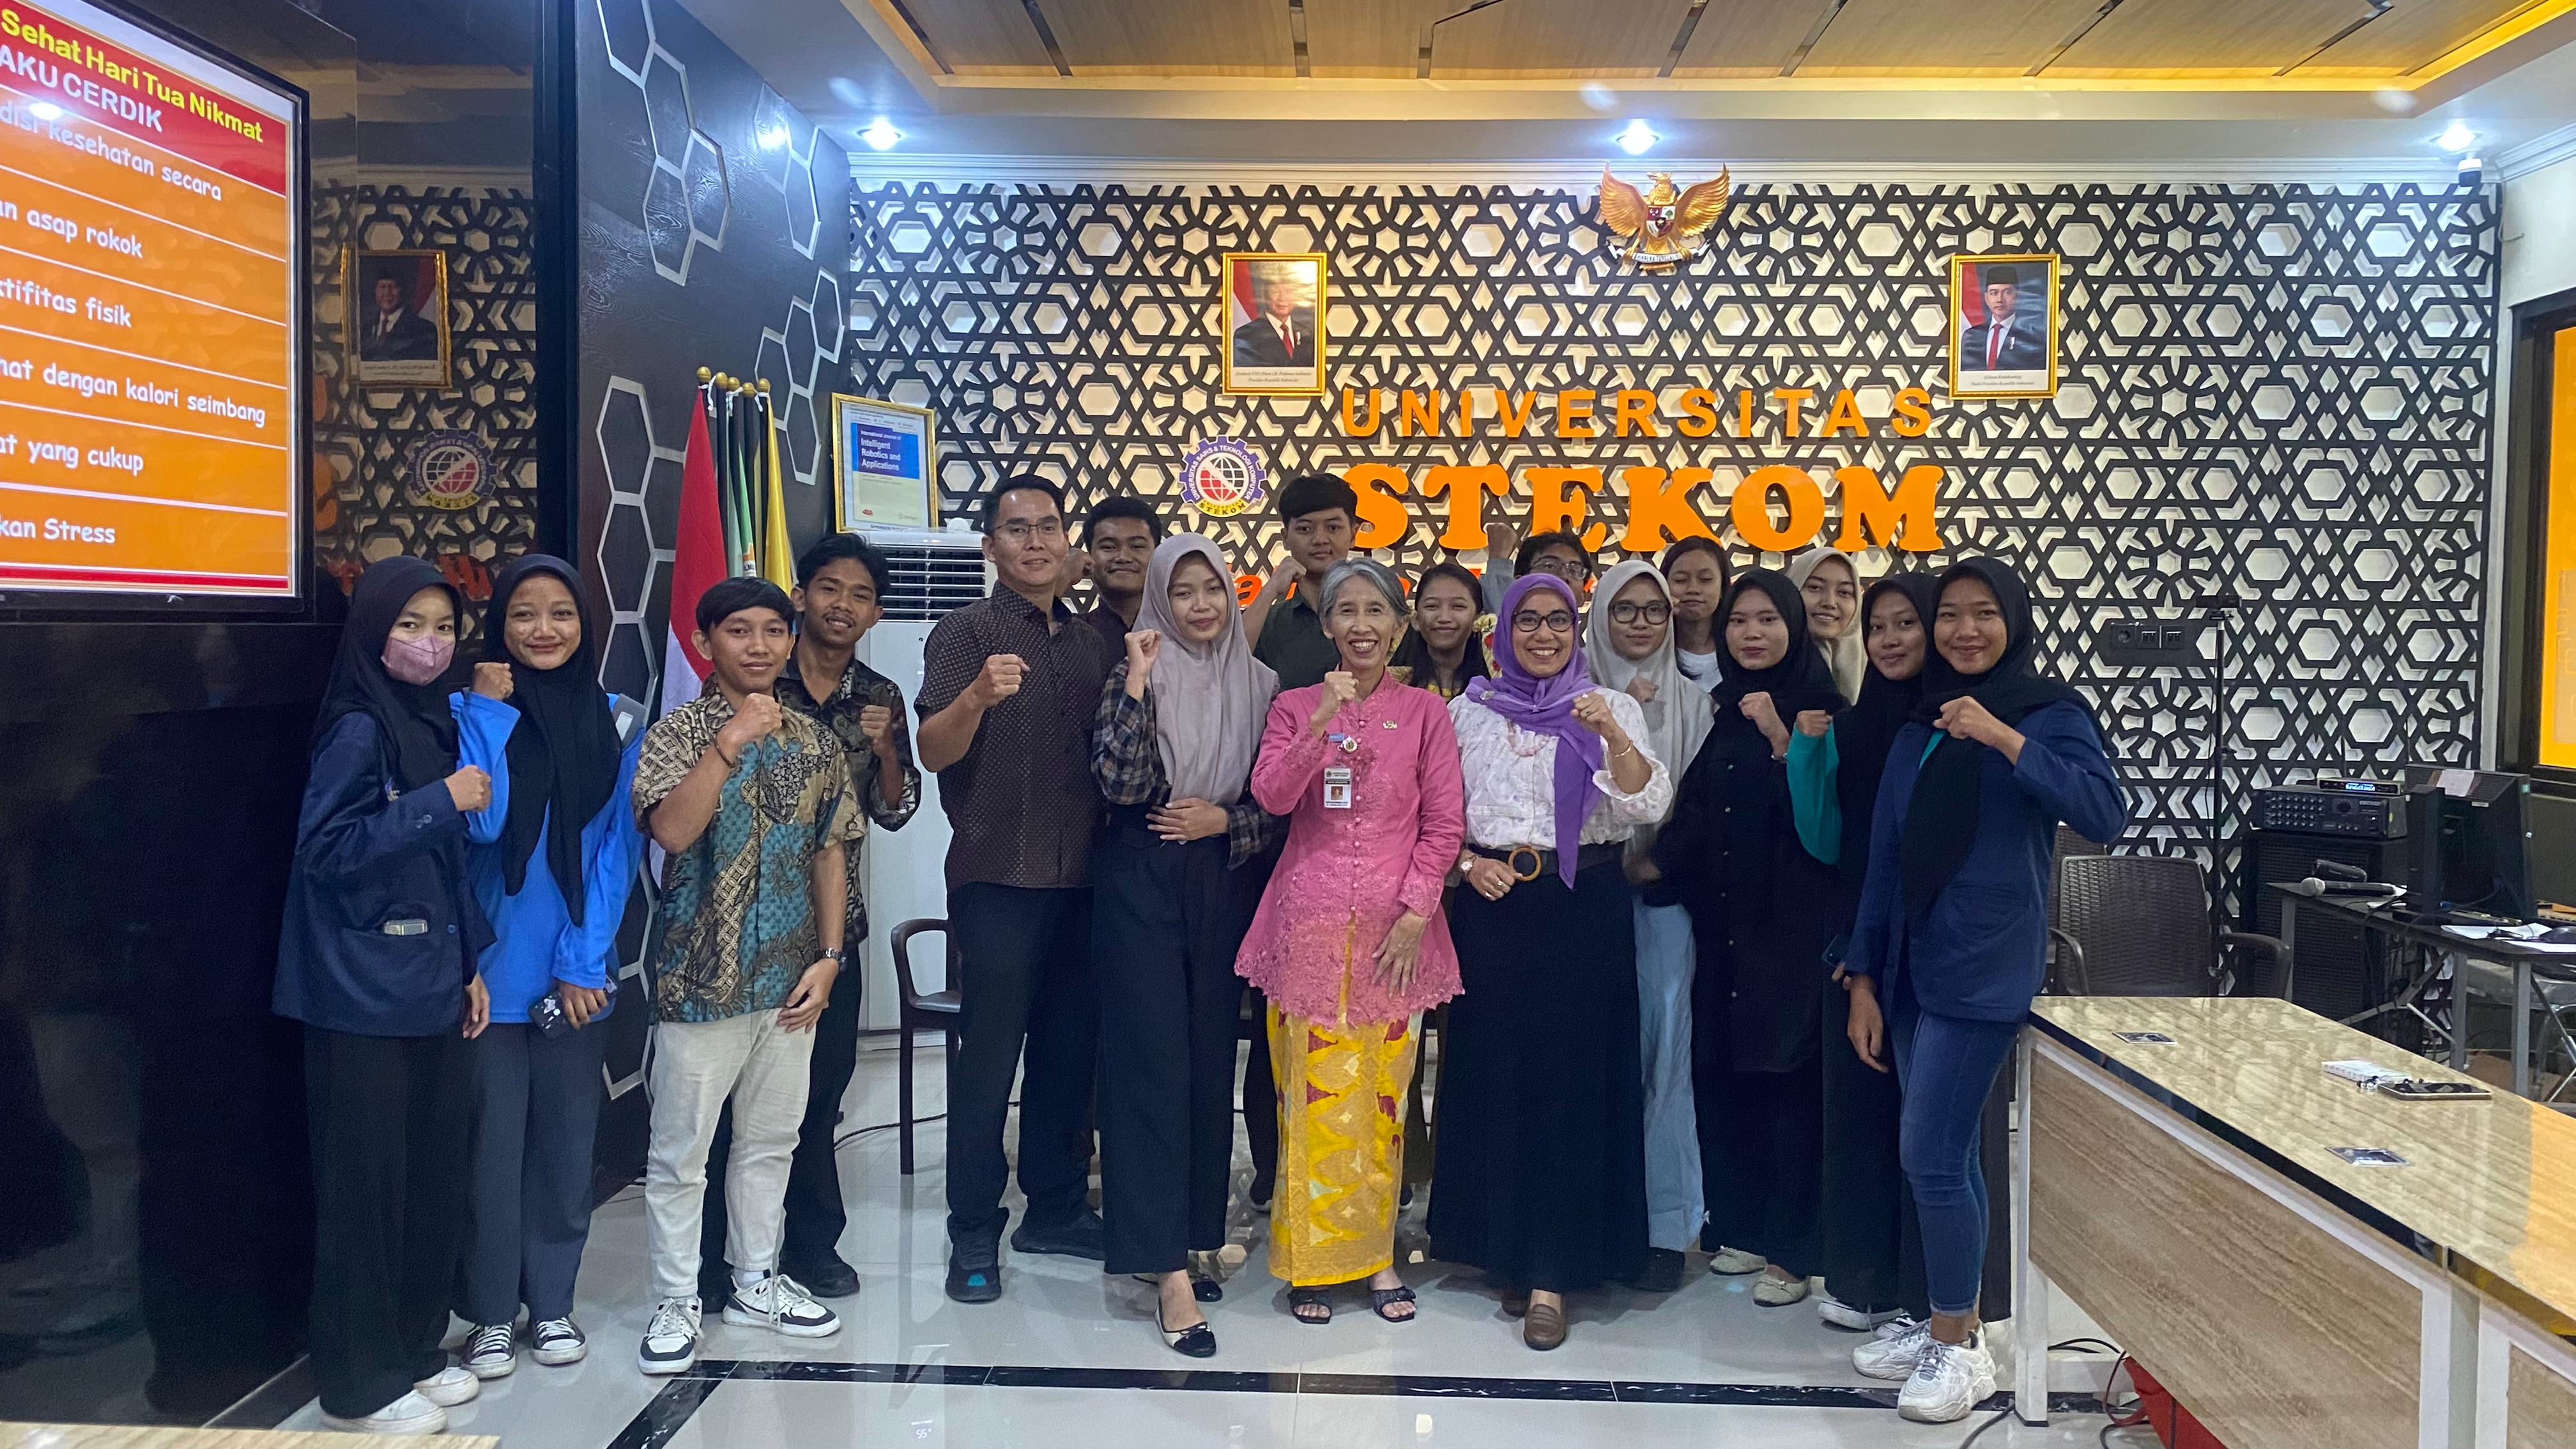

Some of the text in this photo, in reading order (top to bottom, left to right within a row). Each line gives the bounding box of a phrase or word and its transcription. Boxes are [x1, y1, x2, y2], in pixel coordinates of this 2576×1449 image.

[1, 8, 264, 144] Sehat Hari Tua Nikmat
[63, 72, 163, 132] CERDIK
[49, 118, 154, 176] kesehatan
[161, 165, 222, 201] secara
[0, 200, 142, 258] n asap rokok
[86, 296, 132, 327] fisik
[43, 362, 118, 397] dengan
[126, 378, 179, 408] kalori
[187, 395, 265, 428] seimbang
[1342, 387, 1931, 438] UNIVERSITAS
[27, 441, 79, 469] yang
[88, 446, 143, 477] cukup
[861, 438, 891, 450] Intelligent
[861, 448, 889, 459] Robotics
[861, 459, 900, 471] Applications
[1219, 445, 1252, 466] TEKNOLOGI
[1244, 464, 1257, 500] KOMPUTER
[43, 518, 116, 544] Stress
[1199, 503, 1246, 515] STEKOM
[1342, 463, 1943, 552] STEKOM
